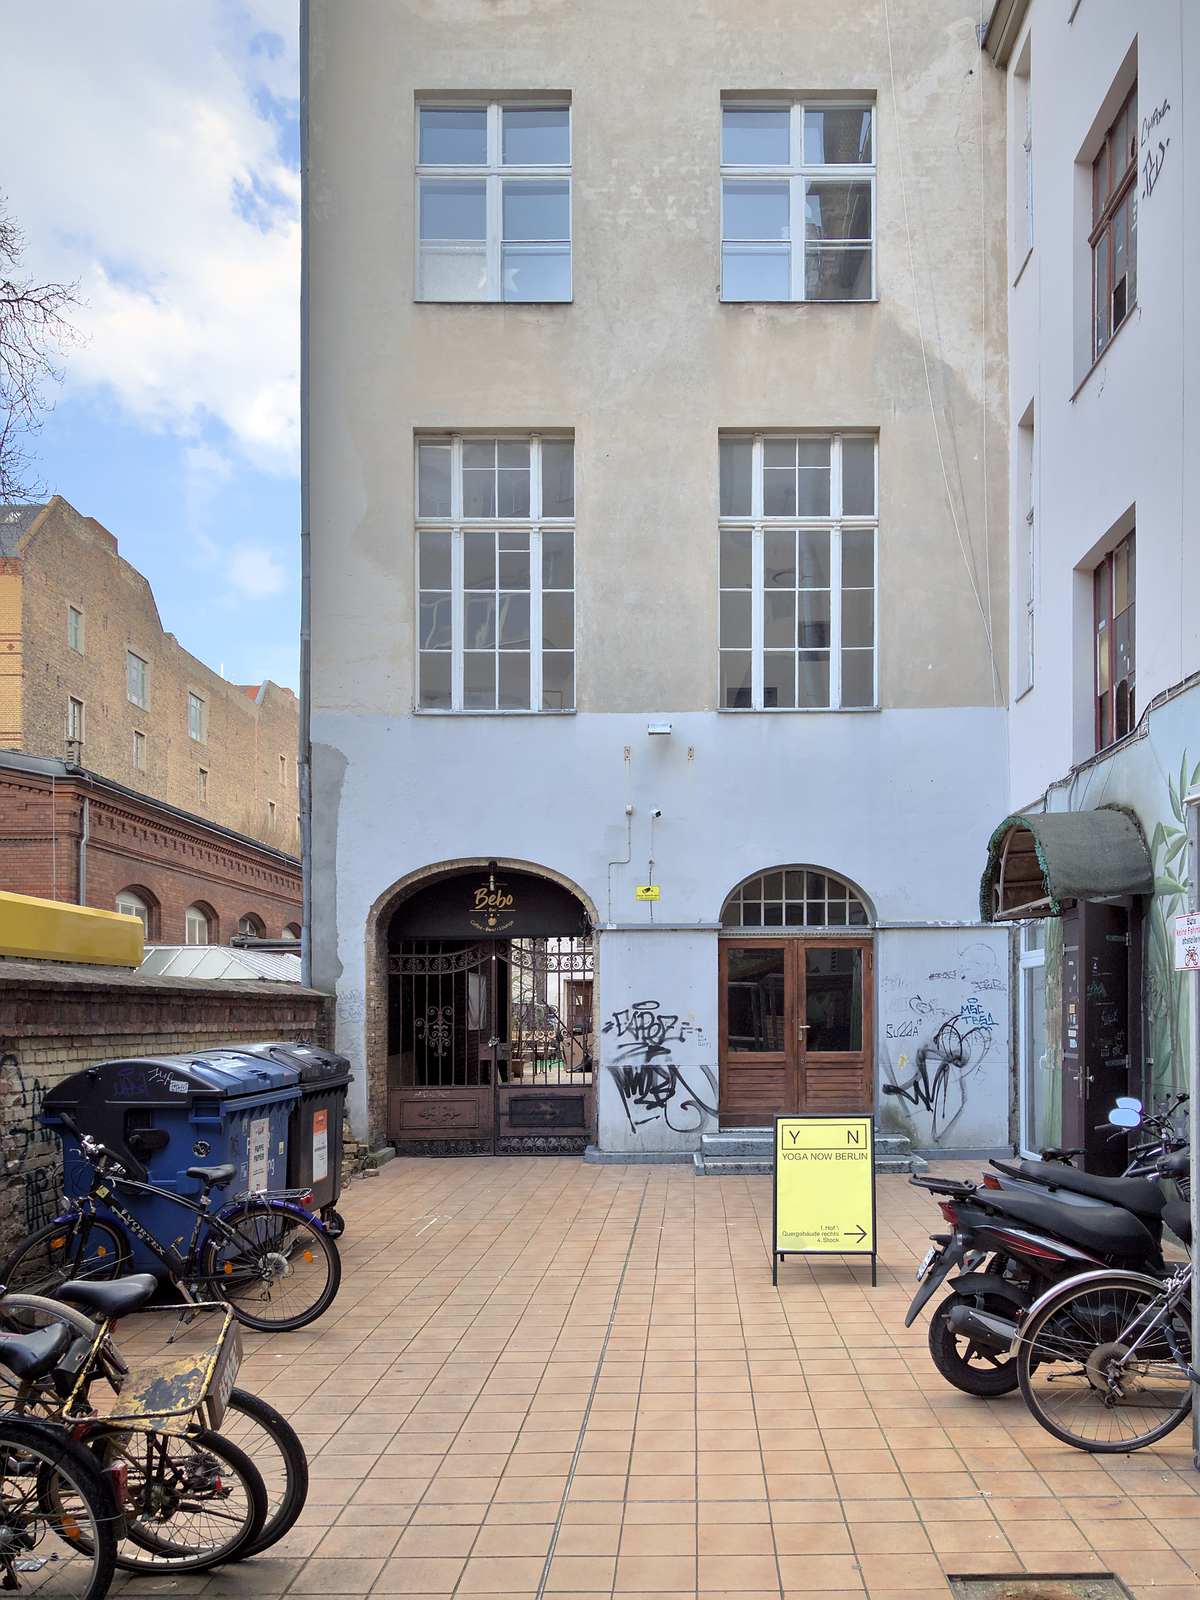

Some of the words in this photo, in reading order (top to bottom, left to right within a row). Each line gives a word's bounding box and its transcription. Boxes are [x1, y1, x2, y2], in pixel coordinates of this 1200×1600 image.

[473, 887, 514, 909] Bebo
[788, 1130, 801, 1145] Y
[847, 1130, 859, 1144] N
[782, 1152, 809, 1161] YOGA
[810, 1152, 833, 1161] NOW
[835, 1152, 868, 1161] BERLIN
[126, 1214, 167, 1256] VORTEX
[781, 1230, 821, 1238] Quergebäude
